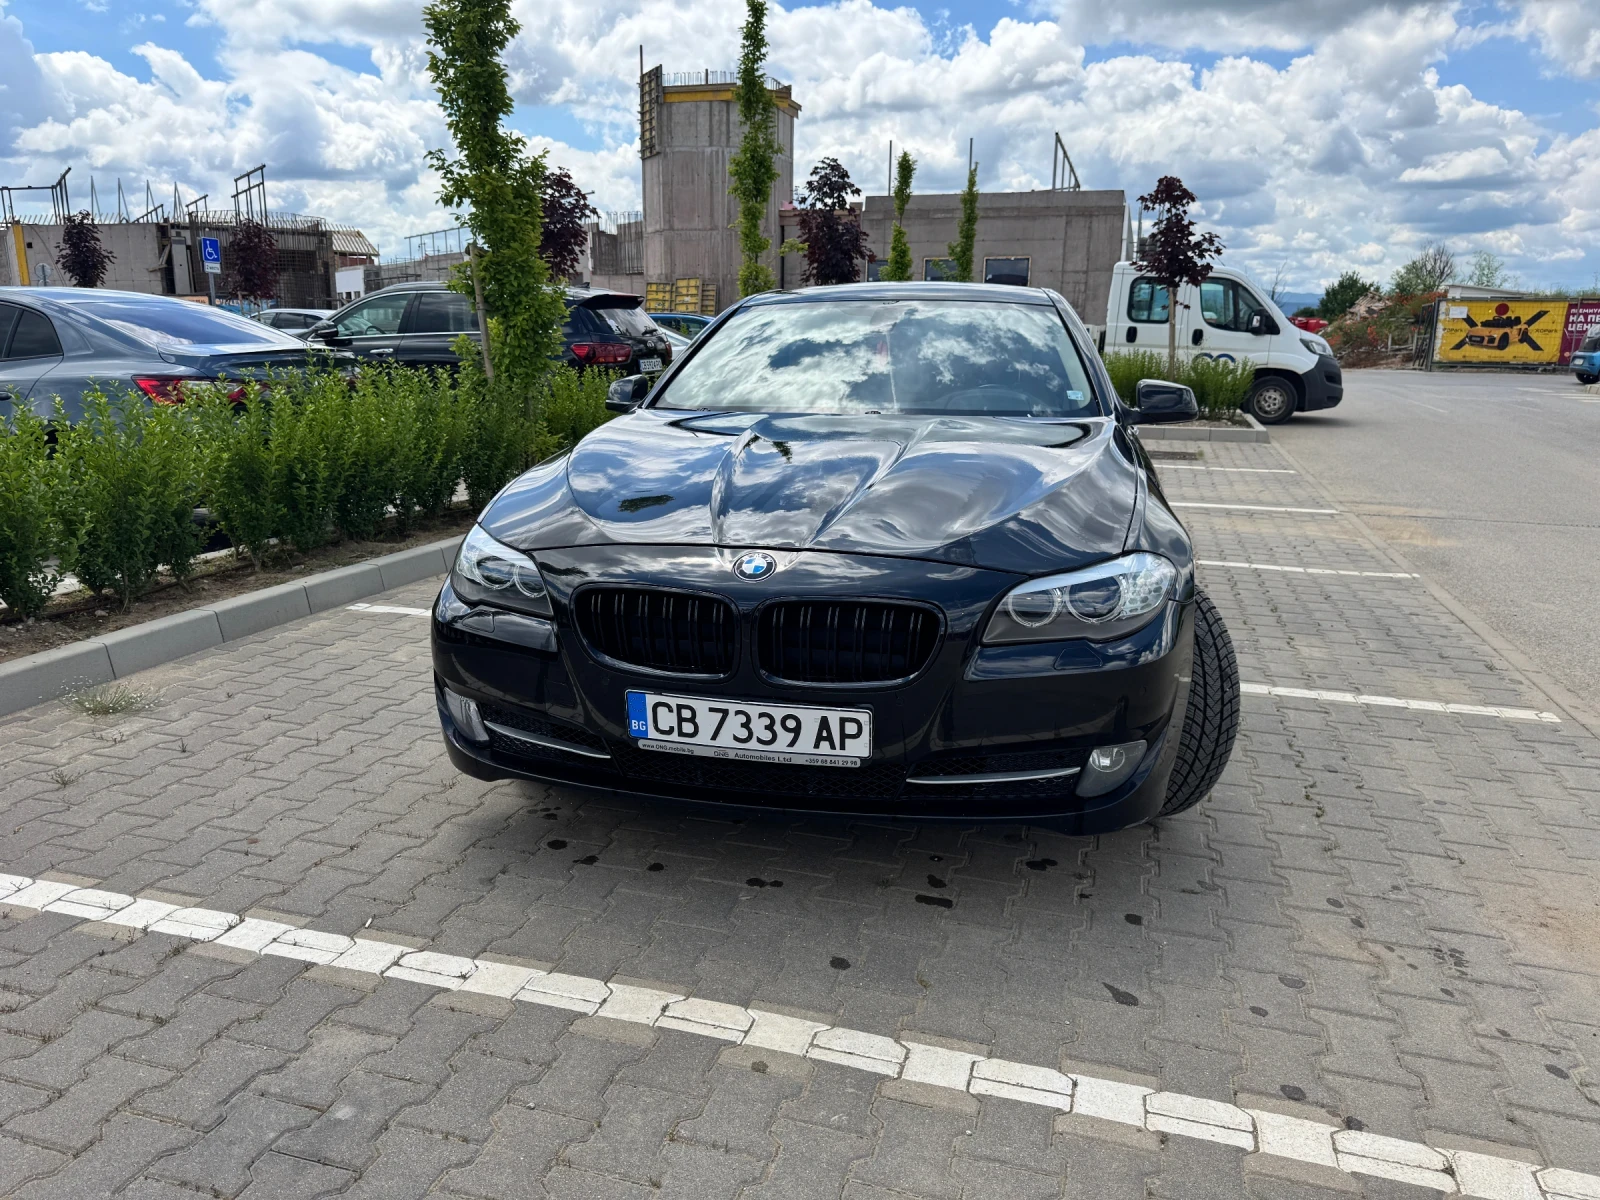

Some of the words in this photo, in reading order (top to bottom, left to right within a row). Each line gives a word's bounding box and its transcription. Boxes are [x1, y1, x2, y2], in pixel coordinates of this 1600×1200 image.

[1568, 323, 1592, 331] ЦЕН
[631, 719, 646, 731] BG
[651, 701, 699, 739] CB
[708, 706, 802, 748] 7339
[813, 715, 863, 751] AP
[734, 752, 776, 762] Automobiles
